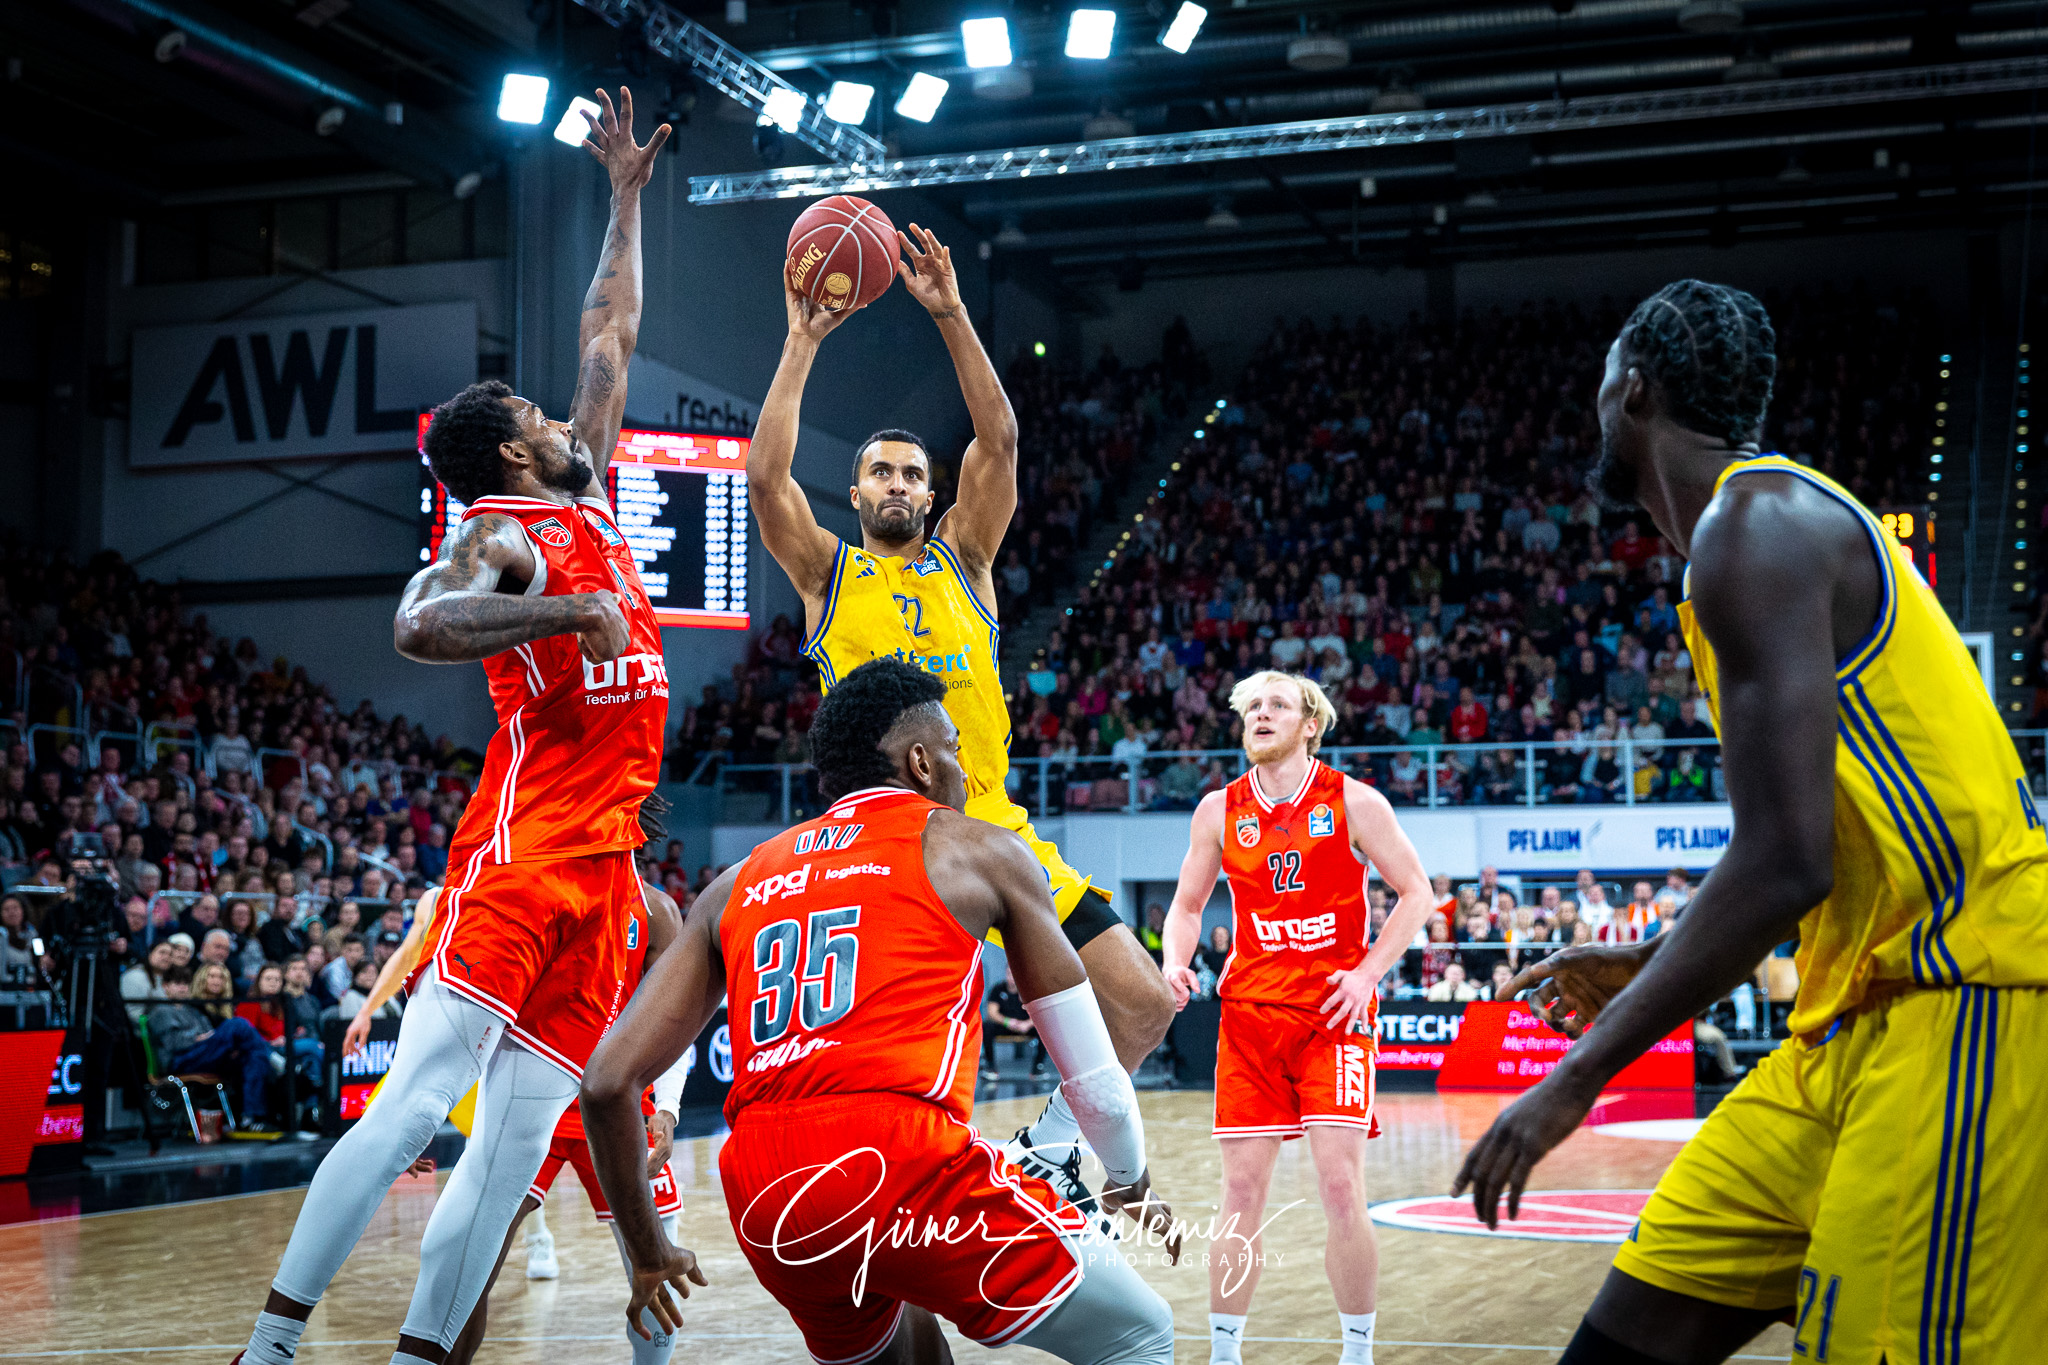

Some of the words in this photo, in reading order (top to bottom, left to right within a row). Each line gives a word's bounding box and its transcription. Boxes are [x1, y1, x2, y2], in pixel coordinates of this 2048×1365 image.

[159, 324, 417, 448] AWL
[794, 824, 864, 855] ONU
[1508, 827, 1582, 851] PFLAUM
[742, 864, 812, 907] xpd
[825, 862, 891, 880] logistics
[781, 886, 806, 900] global
[1267, 850, 1305, 894] 22
[1250, 912, 1337, 942] brose
[750, 905, 861, 1047] 35
[1793, 1264, 1842, 1364] 21
